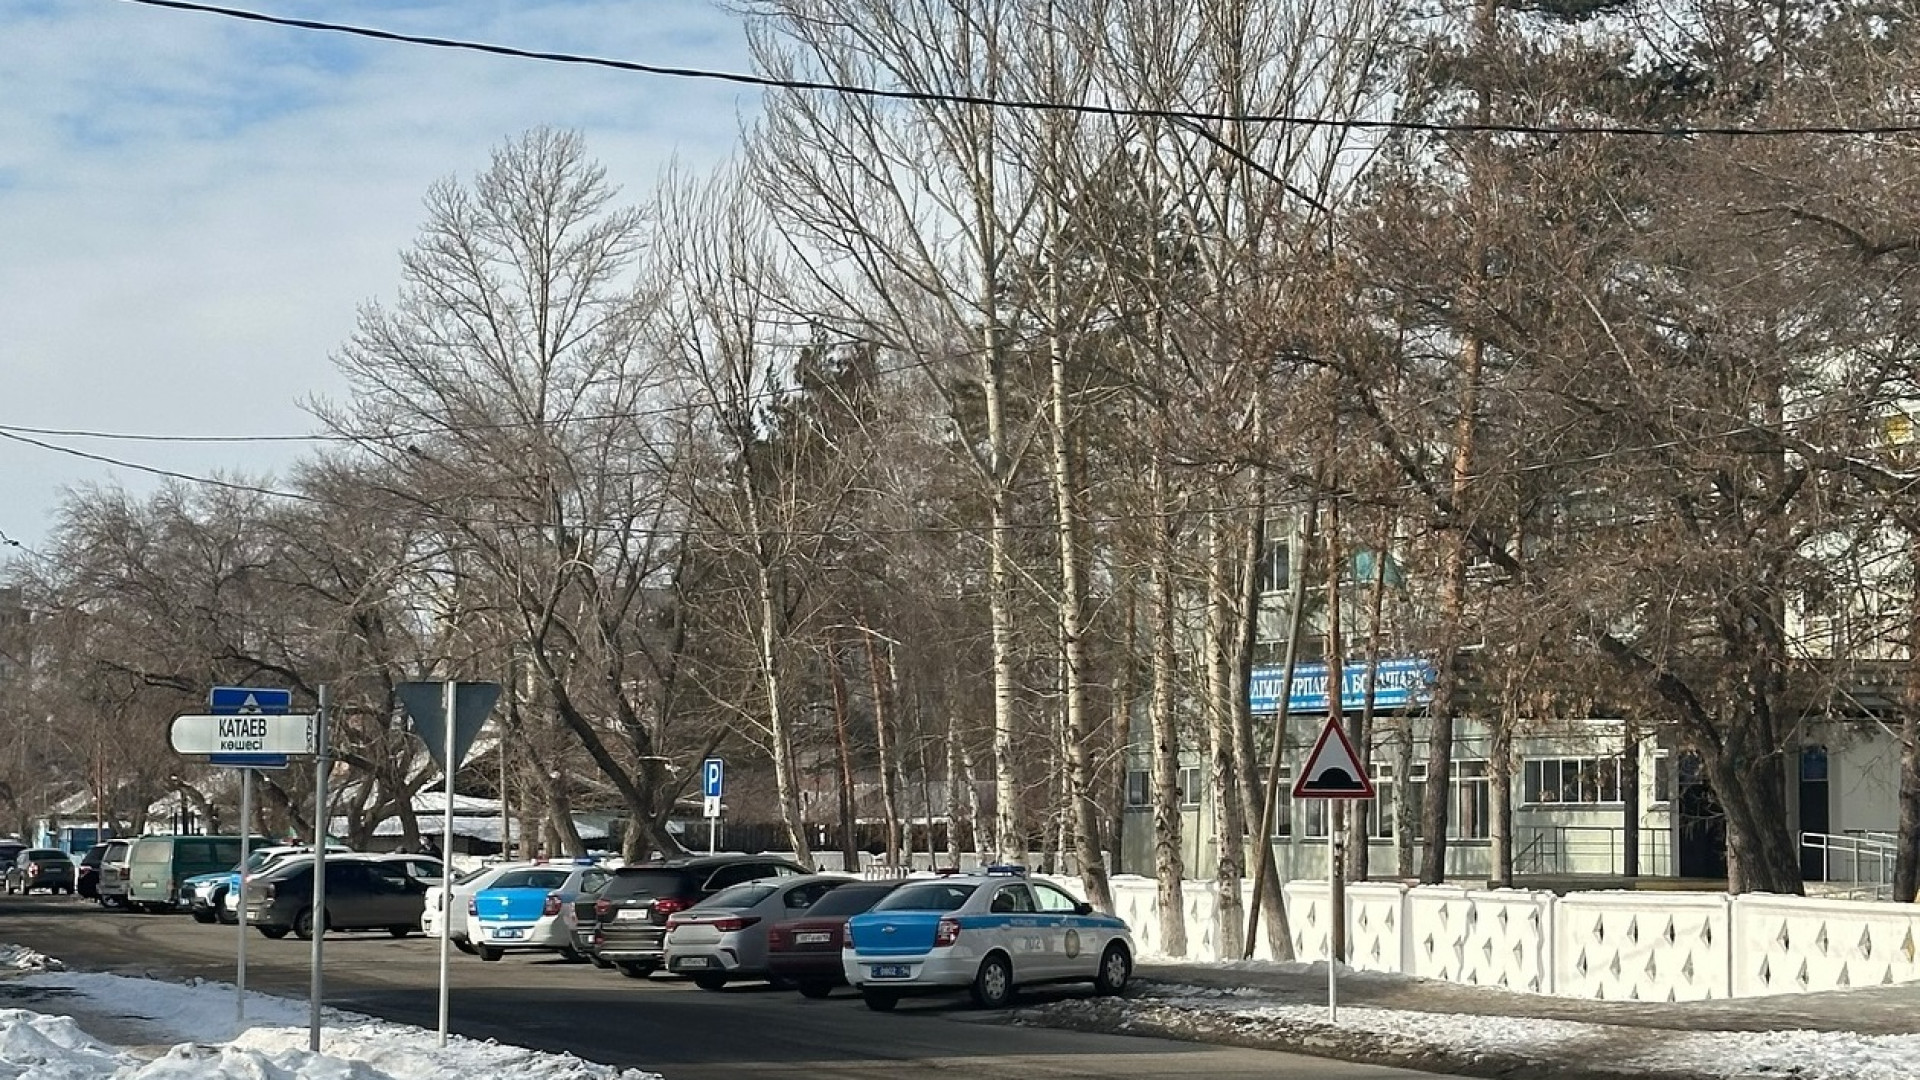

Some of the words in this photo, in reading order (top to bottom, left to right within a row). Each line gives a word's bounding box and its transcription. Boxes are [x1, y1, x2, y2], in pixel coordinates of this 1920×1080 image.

[219, 719, 267, 737] КАТАЕВ
[220, 739, 263, 750] көшесі
[709, 764, 719, 793] P
